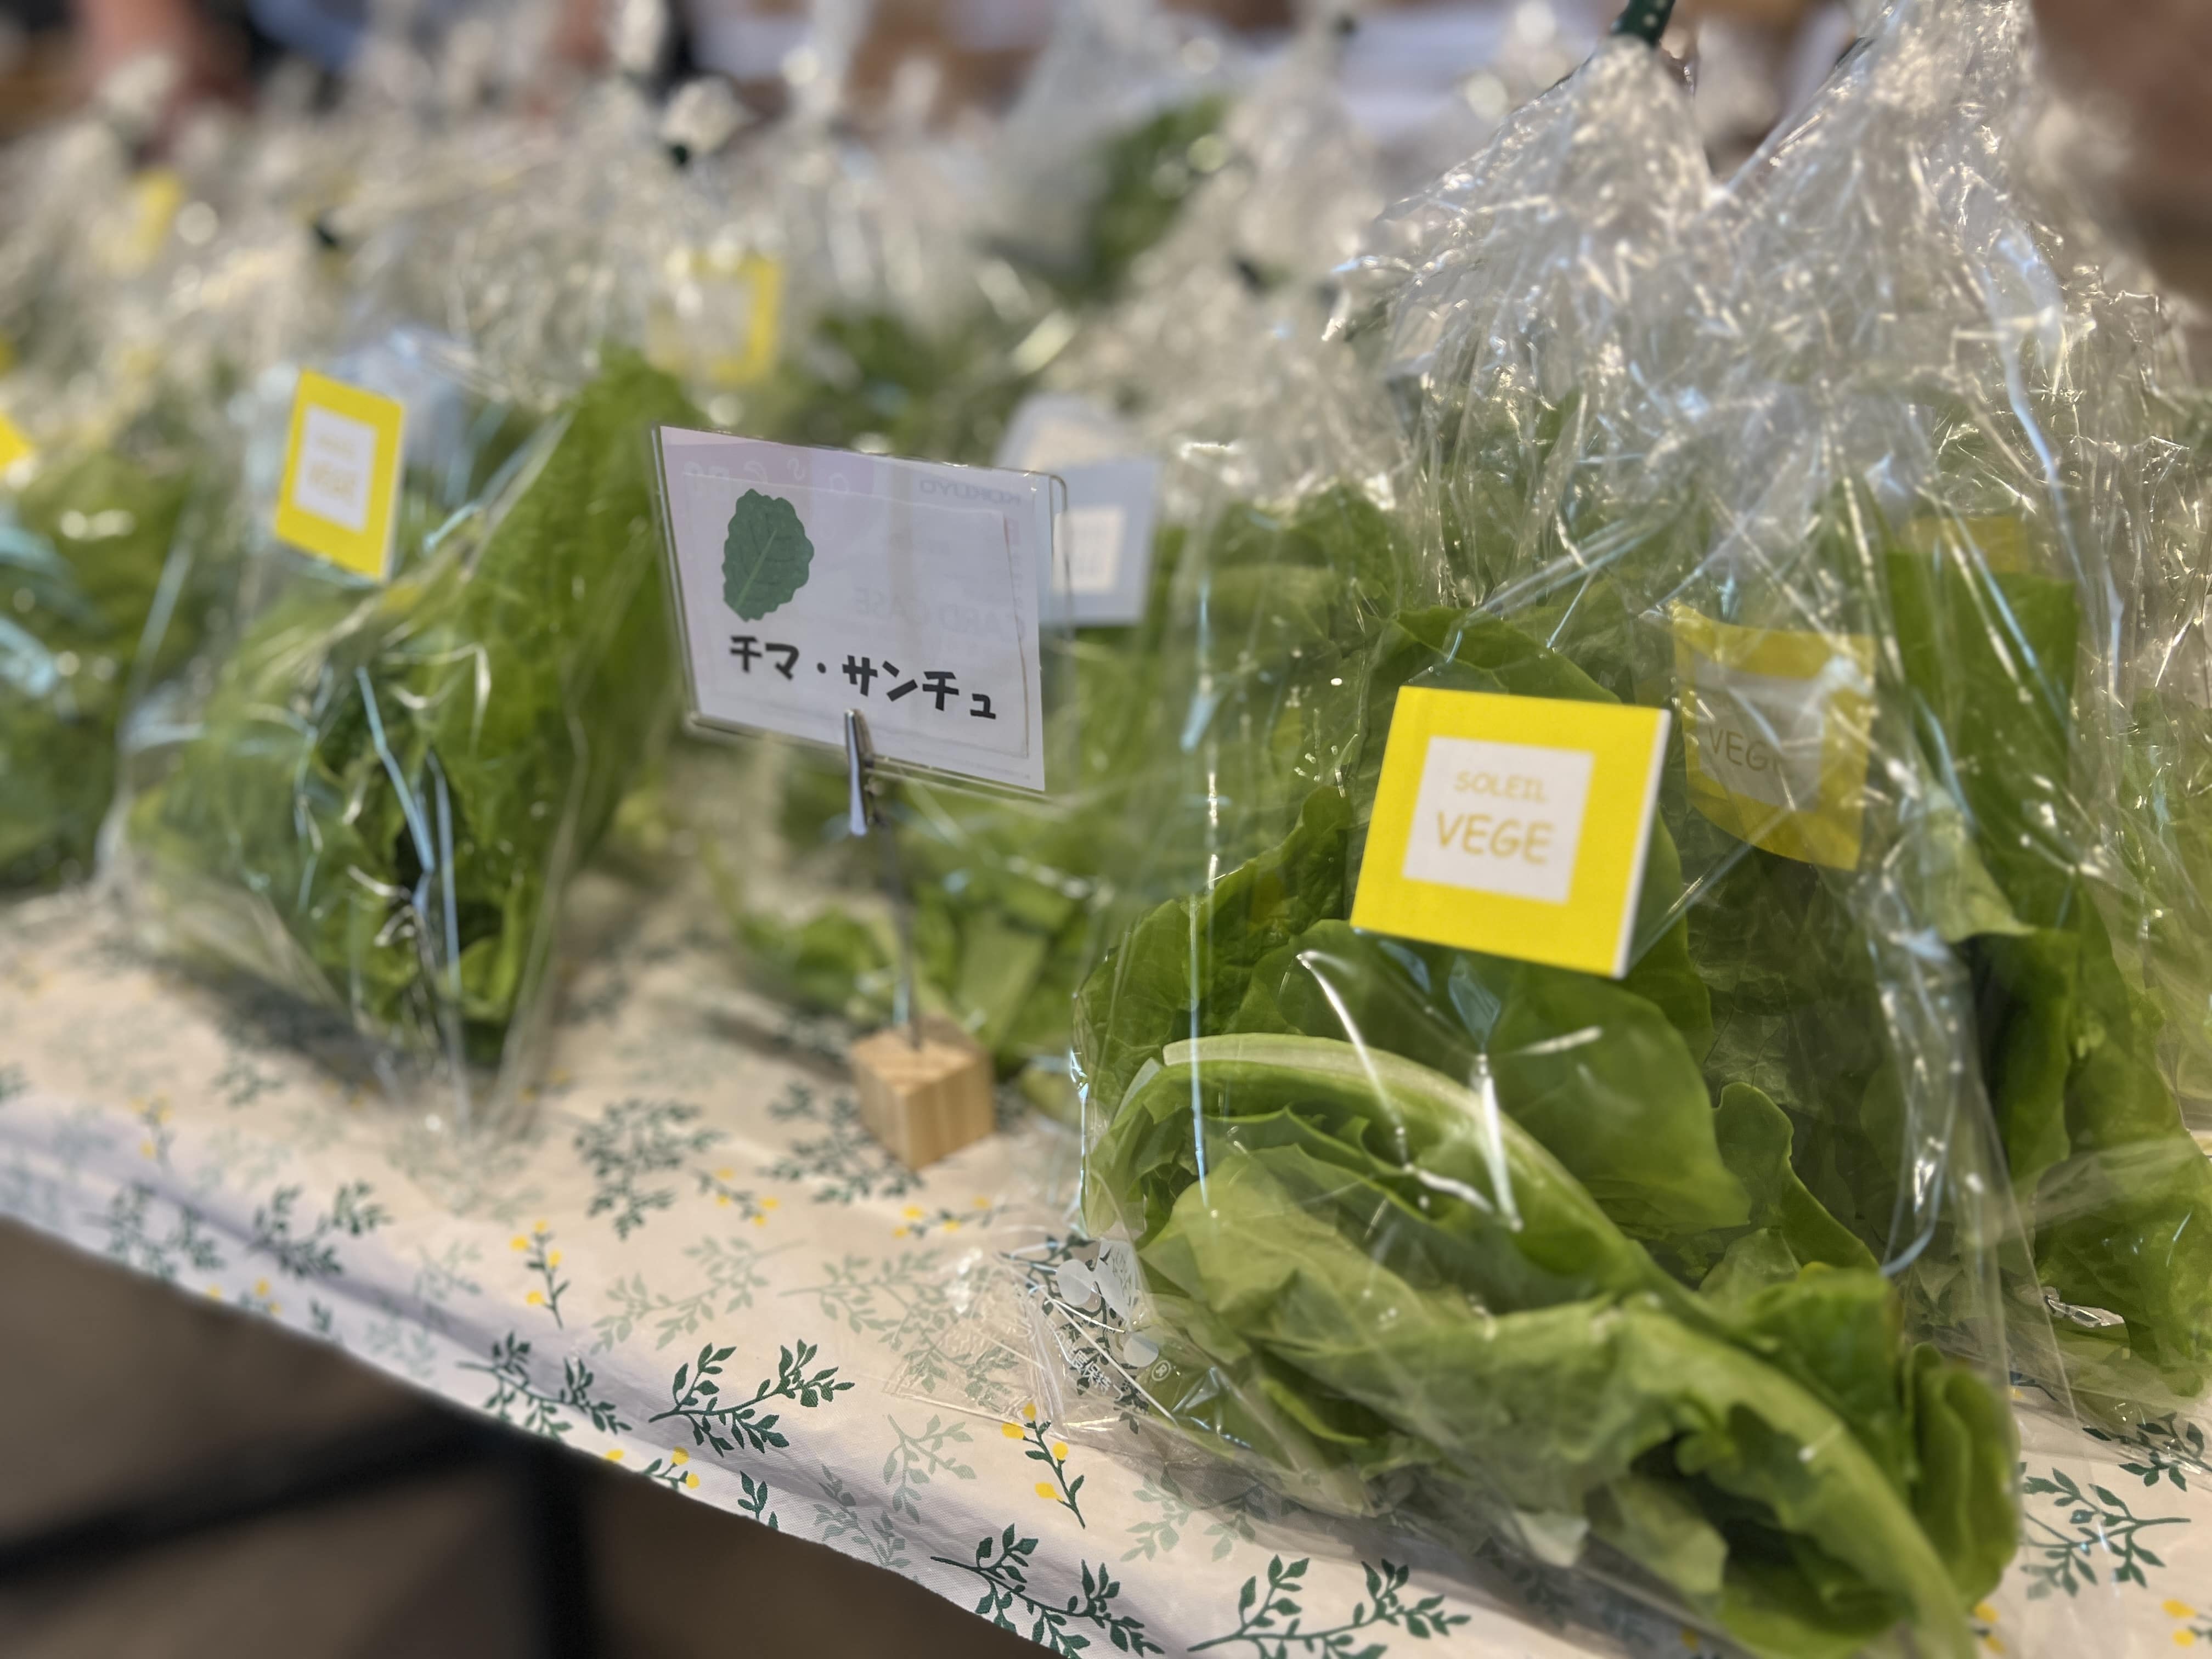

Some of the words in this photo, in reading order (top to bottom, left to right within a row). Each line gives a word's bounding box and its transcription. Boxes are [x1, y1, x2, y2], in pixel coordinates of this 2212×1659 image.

[729, 634, 997, 720] チマ・サンチュ
[1453, 770, 1548, 803] SOLEIL
[1436, 810, 1555, 866] VEGE
